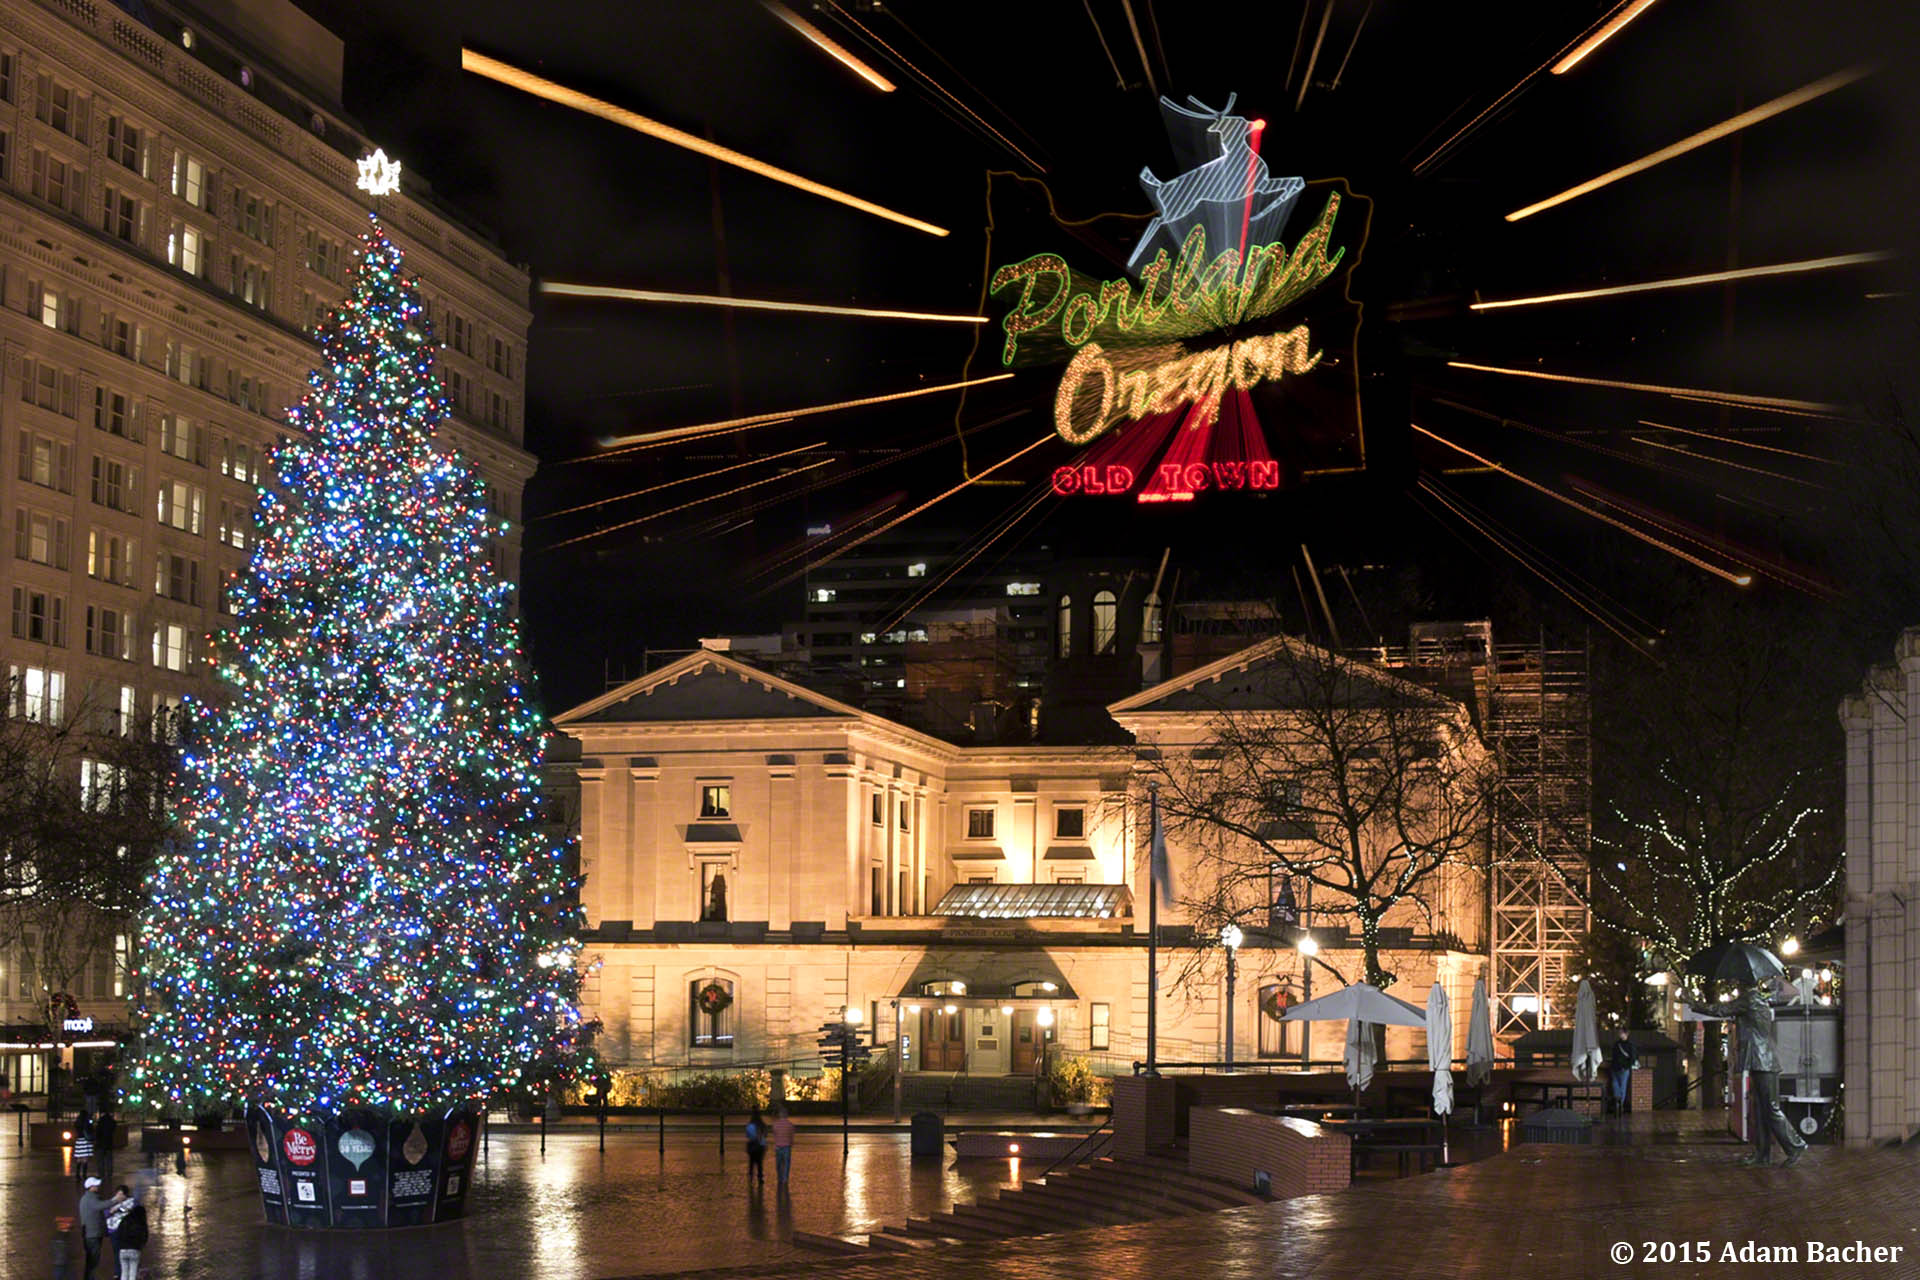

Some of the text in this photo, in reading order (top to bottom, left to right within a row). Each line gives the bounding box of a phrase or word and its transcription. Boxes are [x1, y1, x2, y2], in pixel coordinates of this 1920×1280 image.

[990, 190, 1345, 366] Portland
[1054, 325, 1323, 444] Oregon
[1052, 461, 1279, 494] OLD TOWN
[286, 1141, 316, 1156] Merry
[293, 1131, 308, 1145] Be
